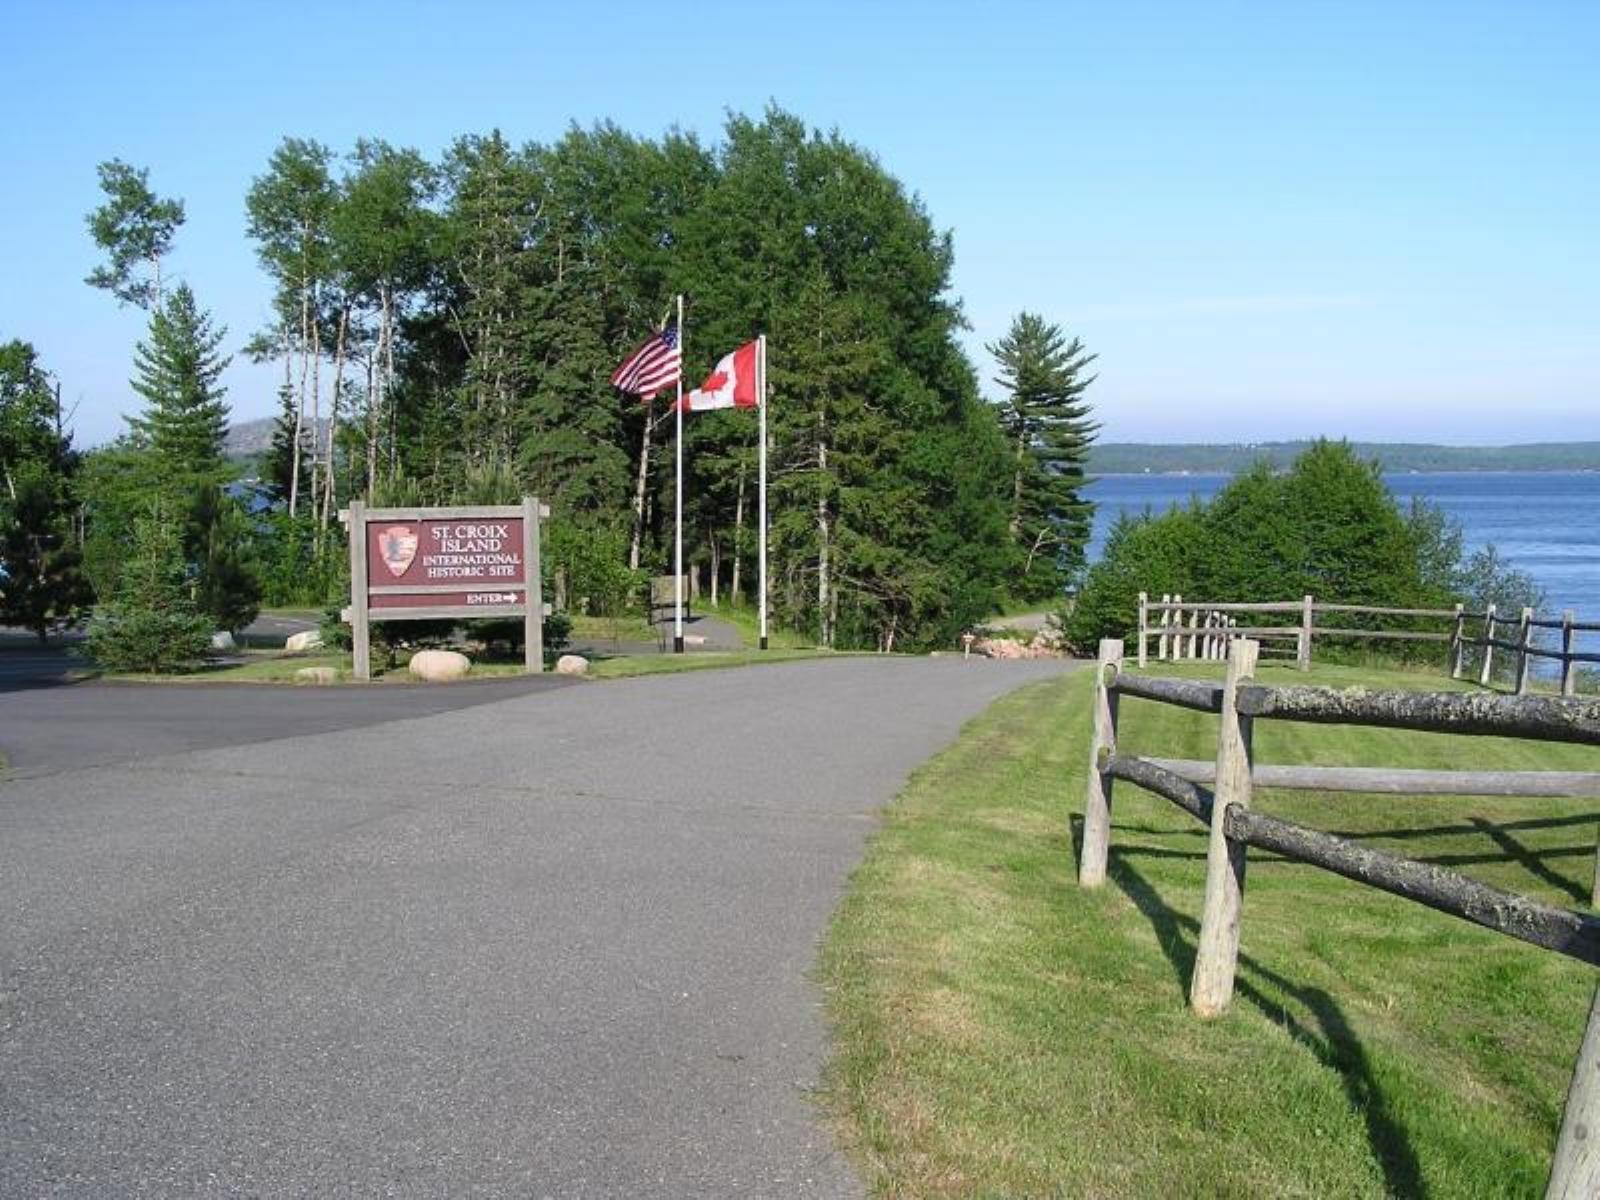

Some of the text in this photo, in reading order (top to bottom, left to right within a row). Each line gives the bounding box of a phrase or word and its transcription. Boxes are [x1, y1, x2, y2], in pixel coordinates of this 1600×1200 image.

[431, 524, 509, 539] ST. CROIX
[440, 539, 502, 553] ISLAND
[422, 554, 521, 566] INTERNATIONAL
[427, 565, 516, 578] HISTORIC SITE
[466, 594, 504, 605] ENTER
